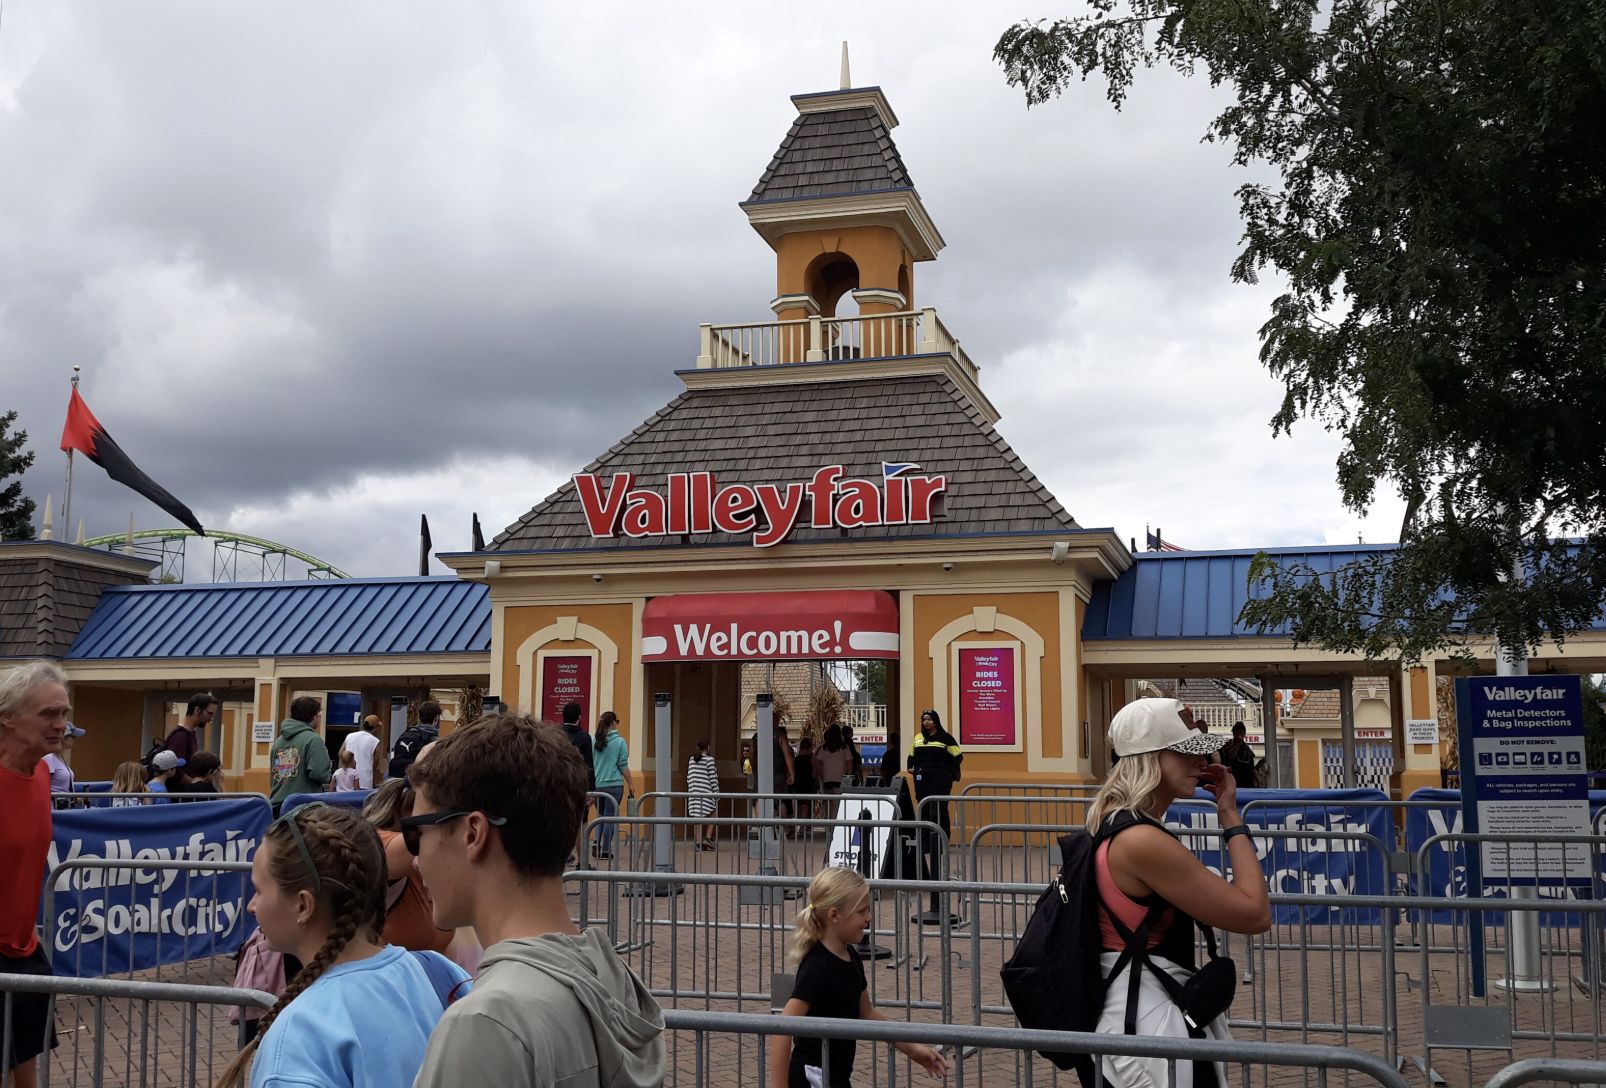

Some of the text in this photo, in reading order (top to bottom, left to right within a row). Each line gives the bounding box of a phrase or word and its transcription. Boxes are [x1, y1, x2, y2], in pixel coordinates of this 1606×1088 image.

[573, 461, 947, 547] Valleyfair
[673, 620, 843, 656] Welcome!
[1483, 686, 1566, 703] Valleyfair
[1482, 718, 1572, 729] & Bag Inspections
[1487, 709, 1566, 718] Metal Detectors
[1165, 813, 1370, 861] allyfair
[47, 830, 255, 893] Valleyfair
[834, 851, 878, 862] STROR
